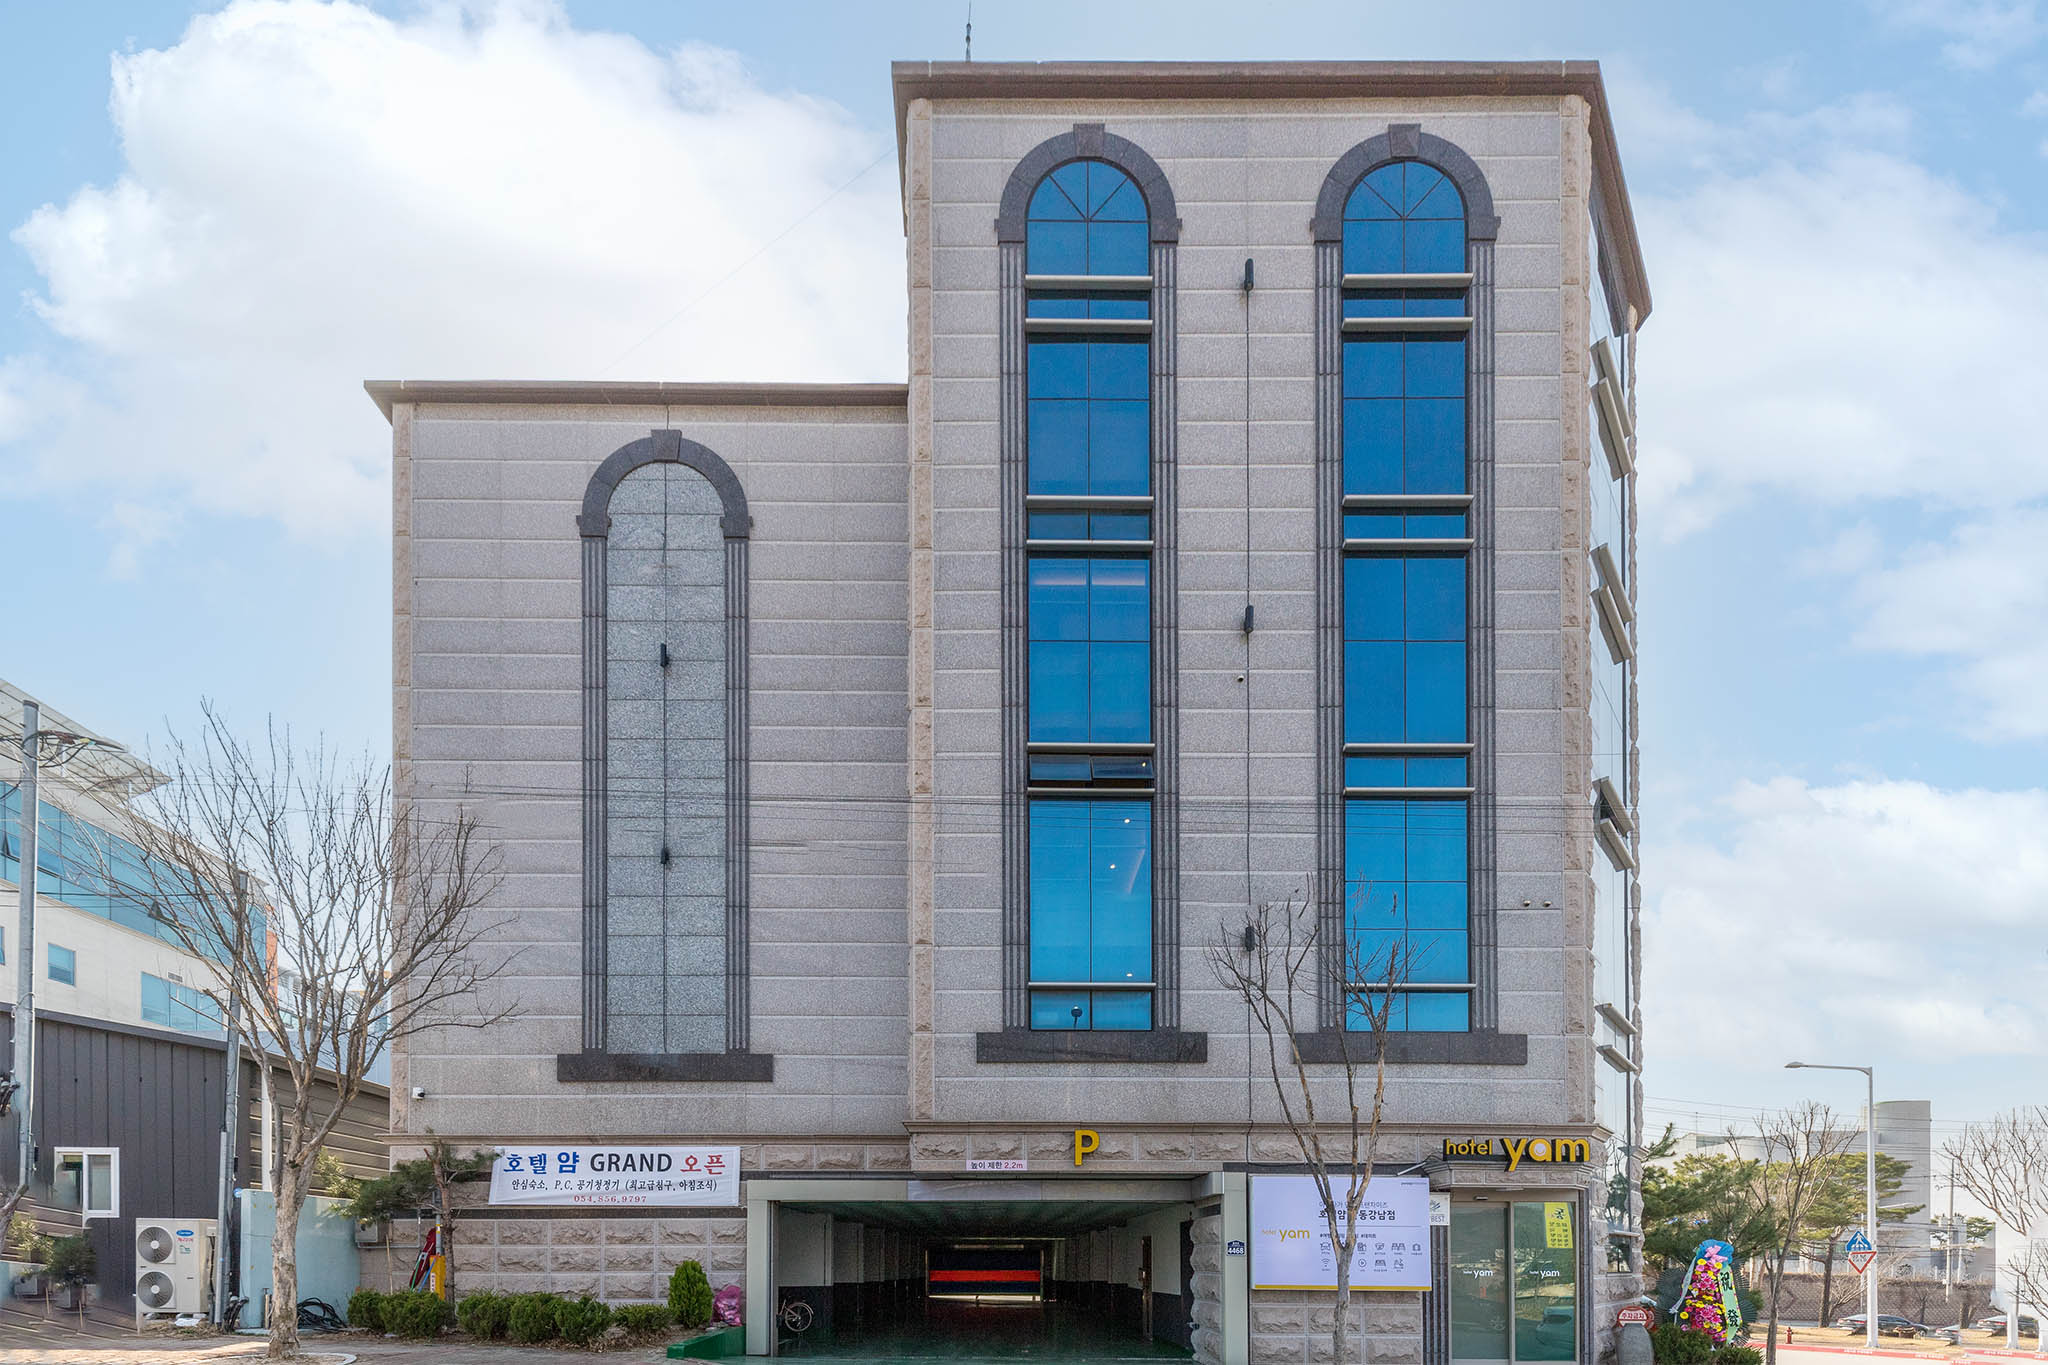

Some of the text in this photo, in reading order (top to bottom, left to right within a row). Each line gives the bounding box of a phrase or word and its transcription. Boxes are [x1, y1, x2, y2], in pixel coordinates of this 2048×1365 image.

[1074, 1129, 1100, 1166] P
[1445, 1138, 1590, 1172] hotel yam
[503, 1151, 726, 1175] 호텔 얌 GRAND 오픈
[971, 1161, 1024, 1170] 높이 제한 2.2m
[576, 1179, 620, 1191] 공기청정기
[1349, 1209, 1396, 1221] 동강남점
[1279, 1229, 1310, 1242] yam
[1473, 1269, 1494, 1279] yam
[1540, 1269, 1560, 1279] yam
